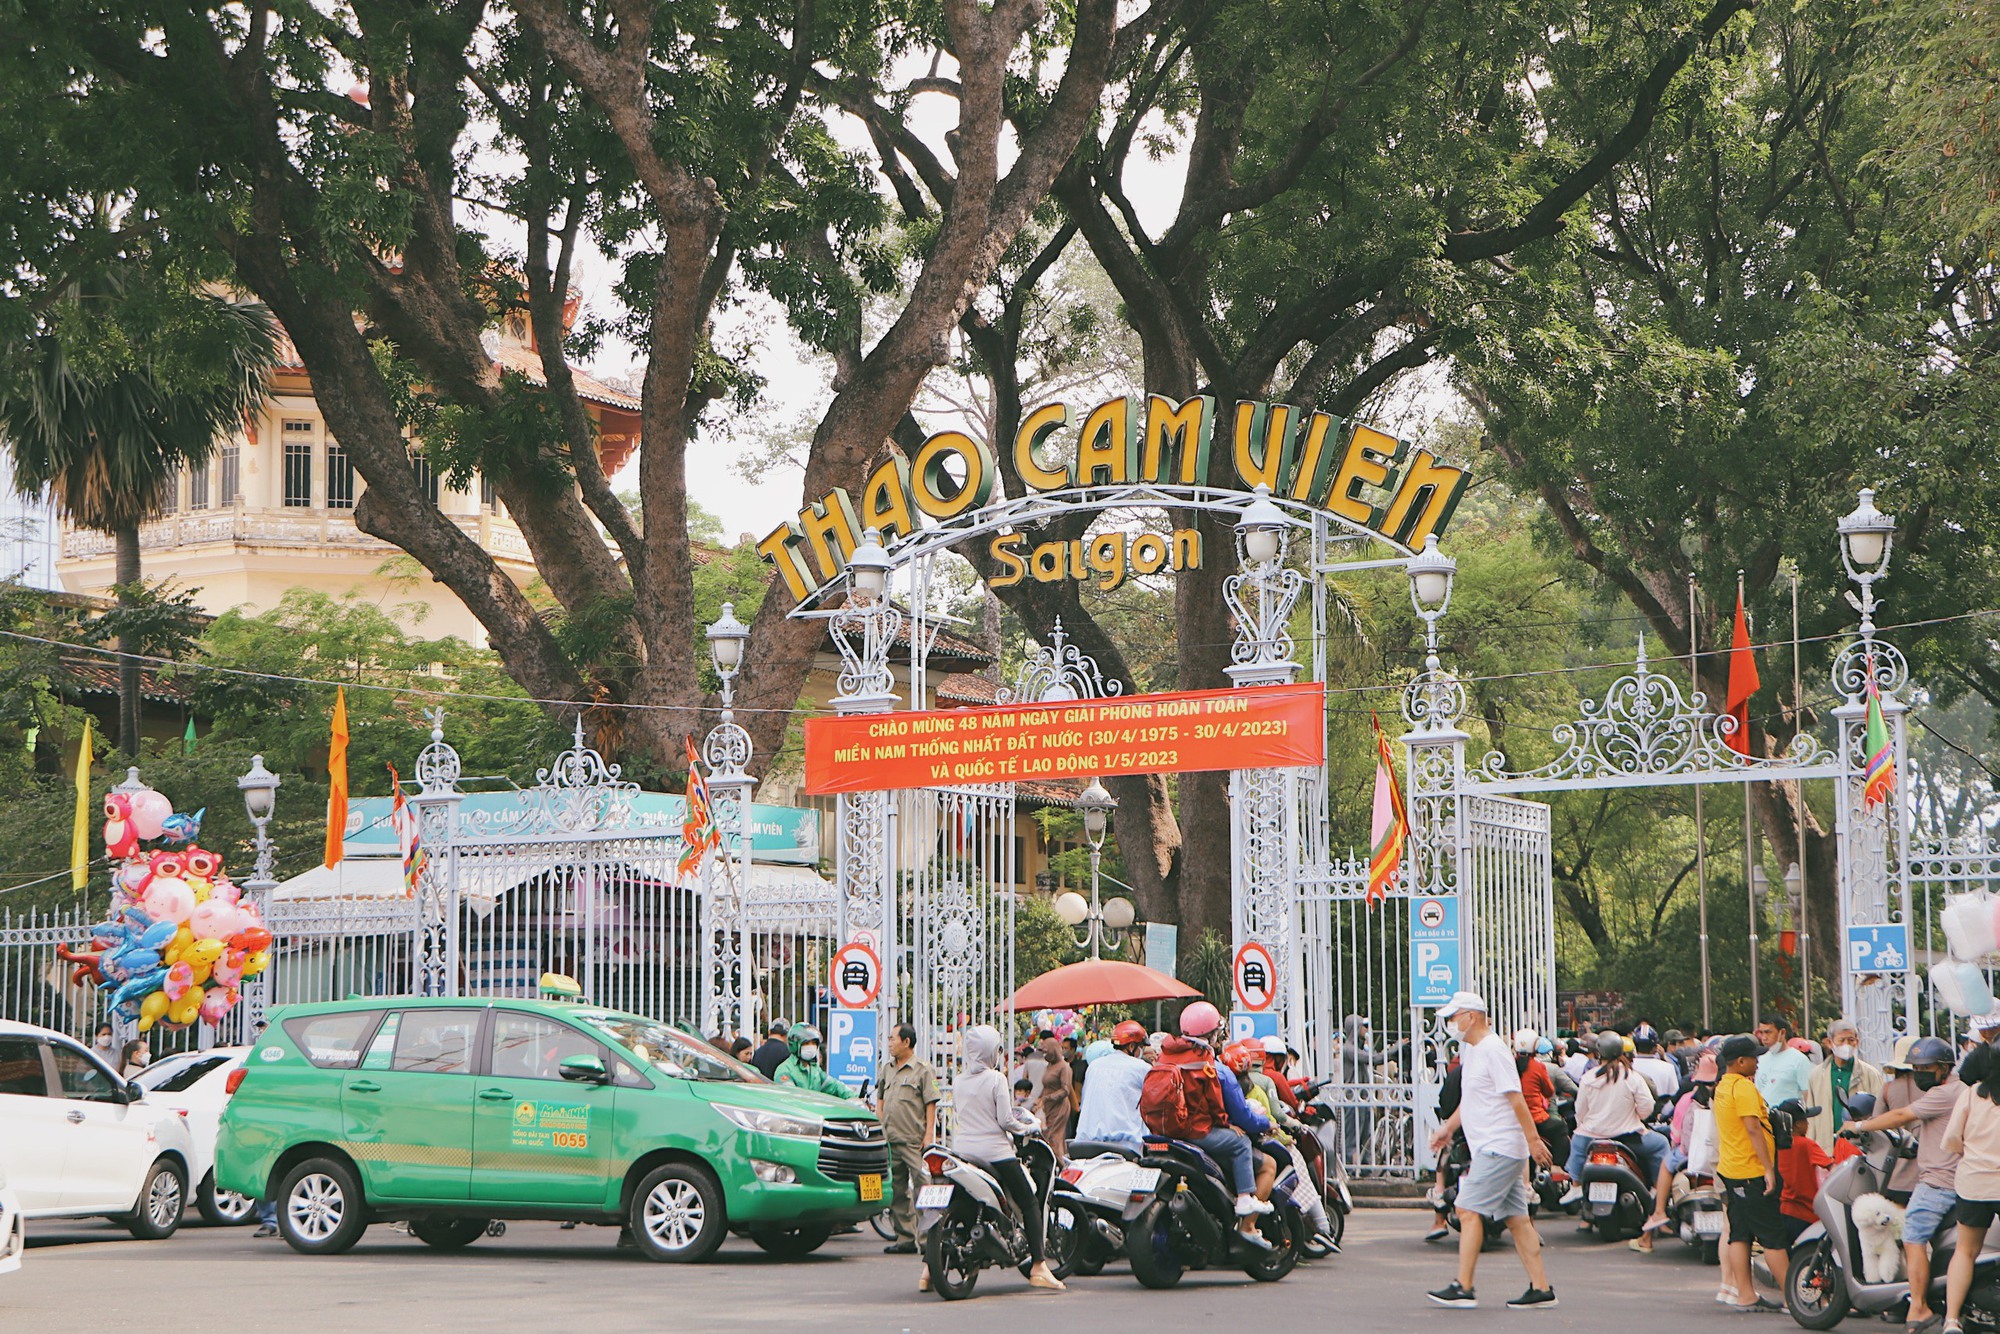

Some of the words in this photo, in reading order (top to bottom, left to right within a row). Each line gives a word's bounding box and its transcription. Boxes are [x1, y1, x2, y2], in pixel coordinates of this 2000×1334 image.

[756, 430, 990, 604] THAO
[1013, 394, 1213, 492] CAM
[988, 528, 1203, 591] Saigon
[869, 719, 907, 737] CHÀO
[912, 717, 954, 733] MỪNG
[958, 717, 977, 730] 48
[1020, 707, 1059, 726] NGÀY
[834, 742, 869, 762] MIỀN
[875, 745, 905, 759] NAM
[909, 737, 958, 756] THỐNG
[963, 734, 1002, 753] NHẤT
[1007, 731, 1036, 750] ĐẤT
[1042, 730, 1082, 747] NƯỚC
[1088, 727, 1178, 746] (30/4/1975
[1194, 720, 1286, 738] 30/4/2023)
[930, 761, 949, 778] VÀ
[954, 757, 993, 777] QUỐC
[998, 755, 1018, 773] TẾ
[1023, 758, 1051, 772] LAO
[1056, 753, 1098, 772] ĐỘNG
[1104, 751, 1177, 767] 1/5/2023
[1417, 942, 1440, 977] P
[1851, 940, 1872, 969] P
[1425, 986, 1446, 994] 50m
[831, 1012, 853, 1054] P
[1232, 1015, 1255, 1042] P
[846, 1063, 867, 1073] 50m
[552, 1132, 587, 1149] 1055
